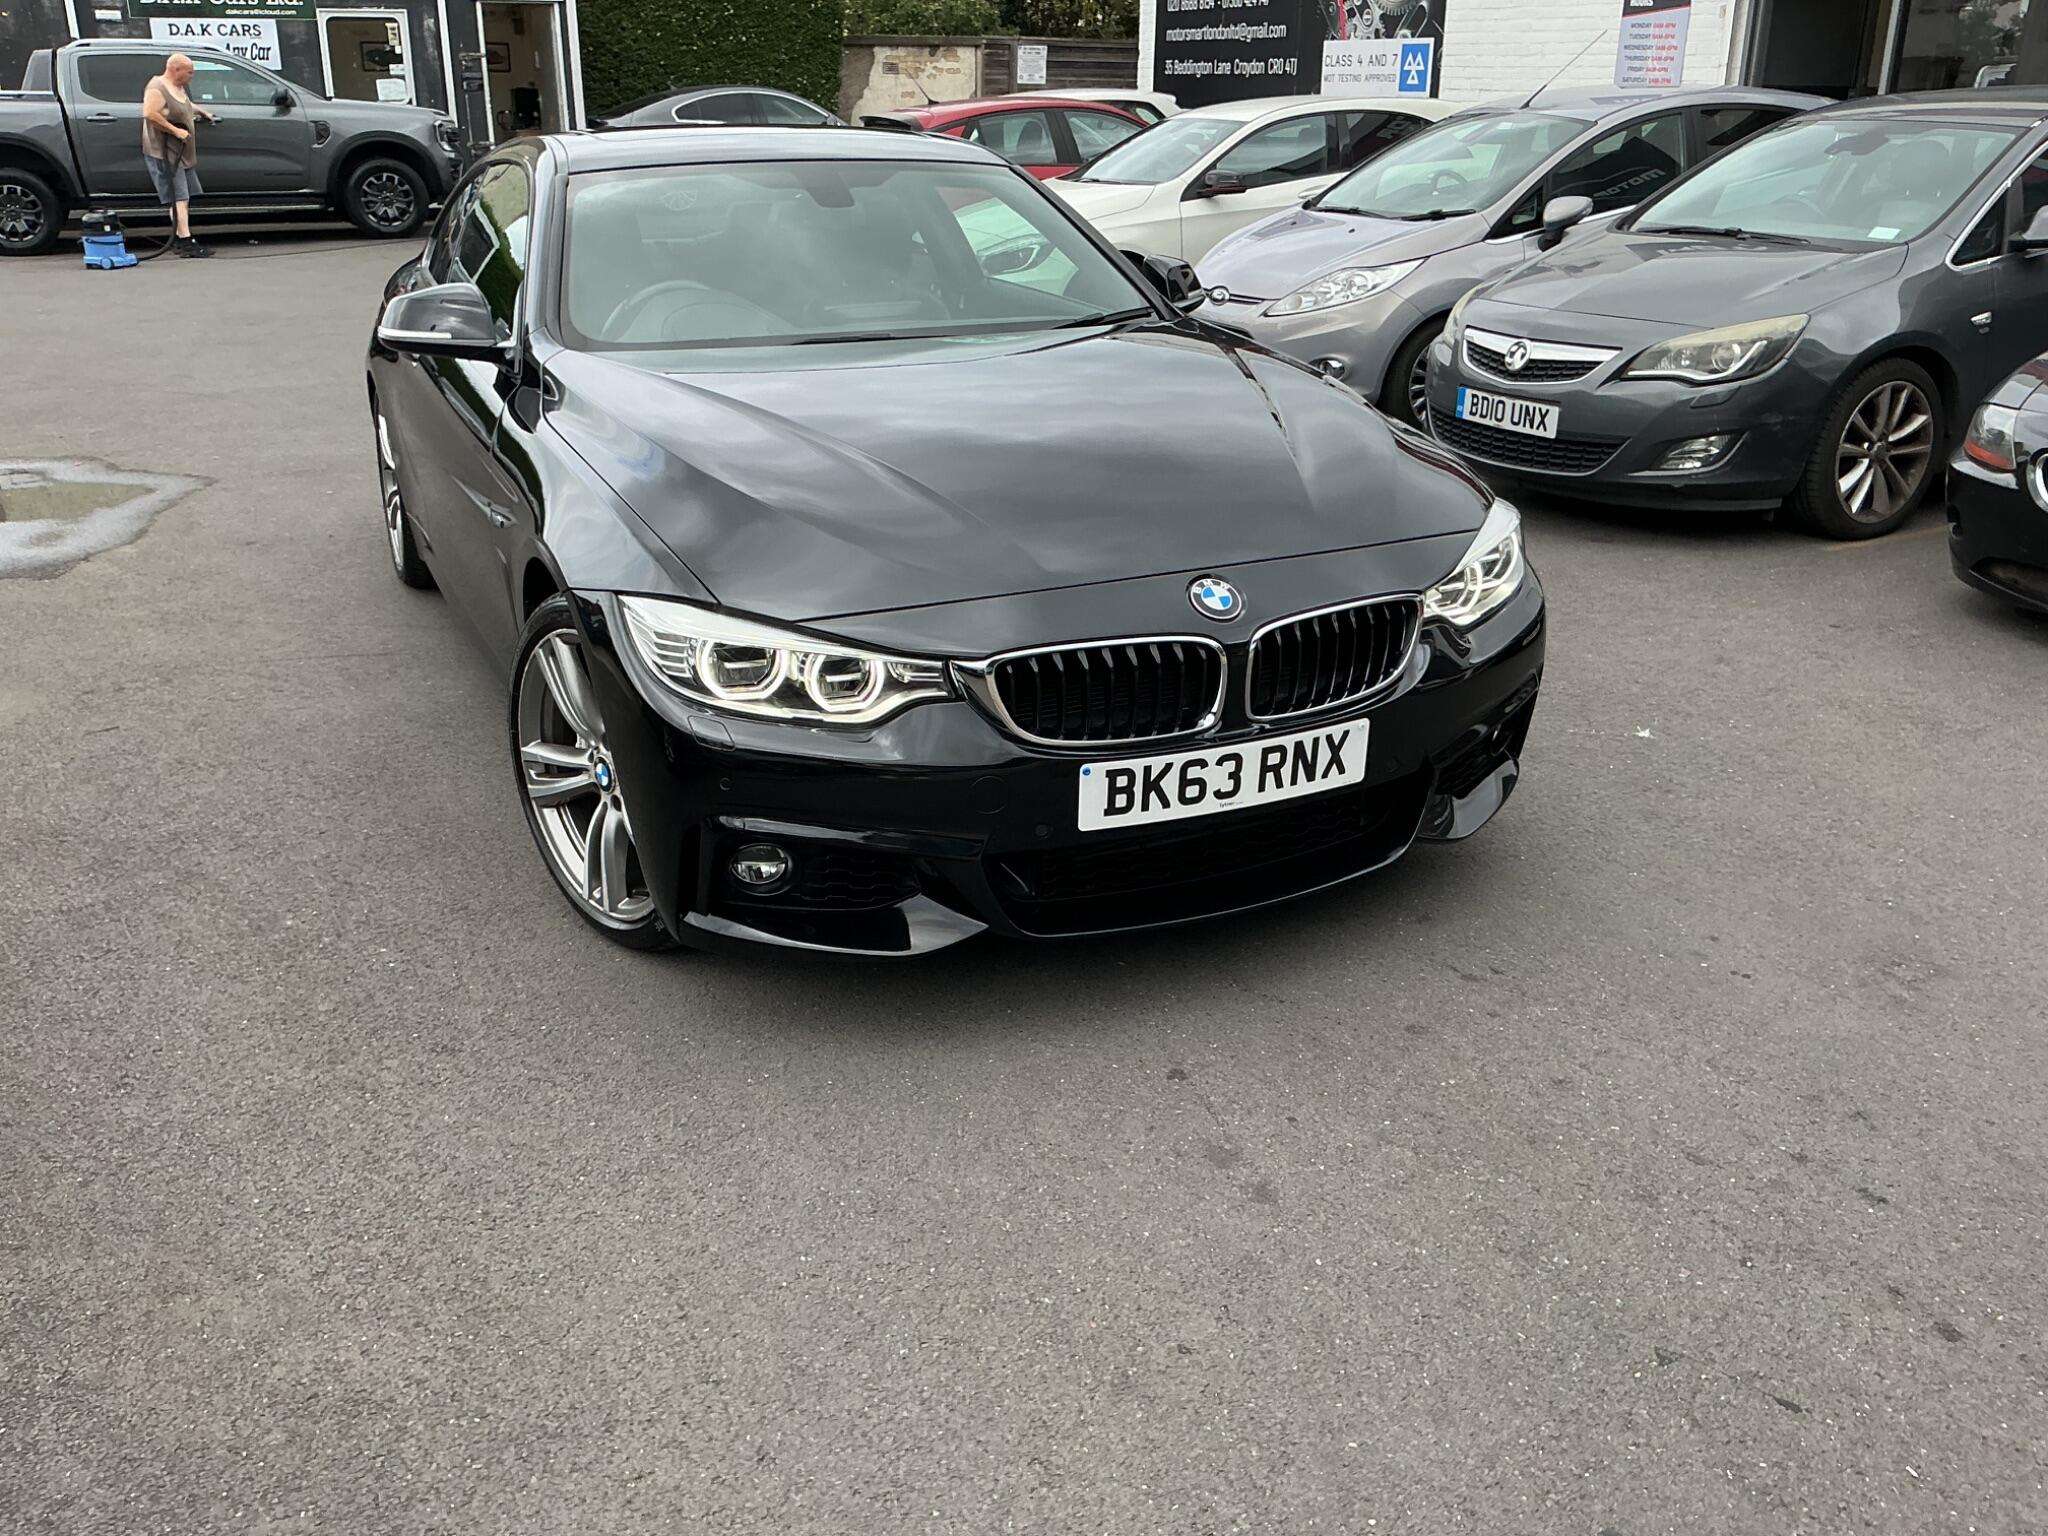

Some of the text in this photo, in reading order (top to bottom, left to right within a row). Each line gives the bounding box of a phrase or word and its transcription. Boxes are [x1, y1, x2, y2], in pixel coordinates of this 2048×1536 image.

[168, 23, 262, 37] D.A.K CARS
[251, 43, 271, 61] Car
[1324, 53, 1399, 67] CLASS 4 AND 7
[1173, 60, 1213, 78] Beddington
[1214, 59, 1231, 75] Lane
[1233, 58, 1265, 78] Croydon
[1338, 74, 1362, 83] TESTING
[1365, 74, 1397, 82] APPROVED
[1469, 393, 1550, 432] BD10 UNX
[1103, 729, 1351, 817] BK63 RNX
